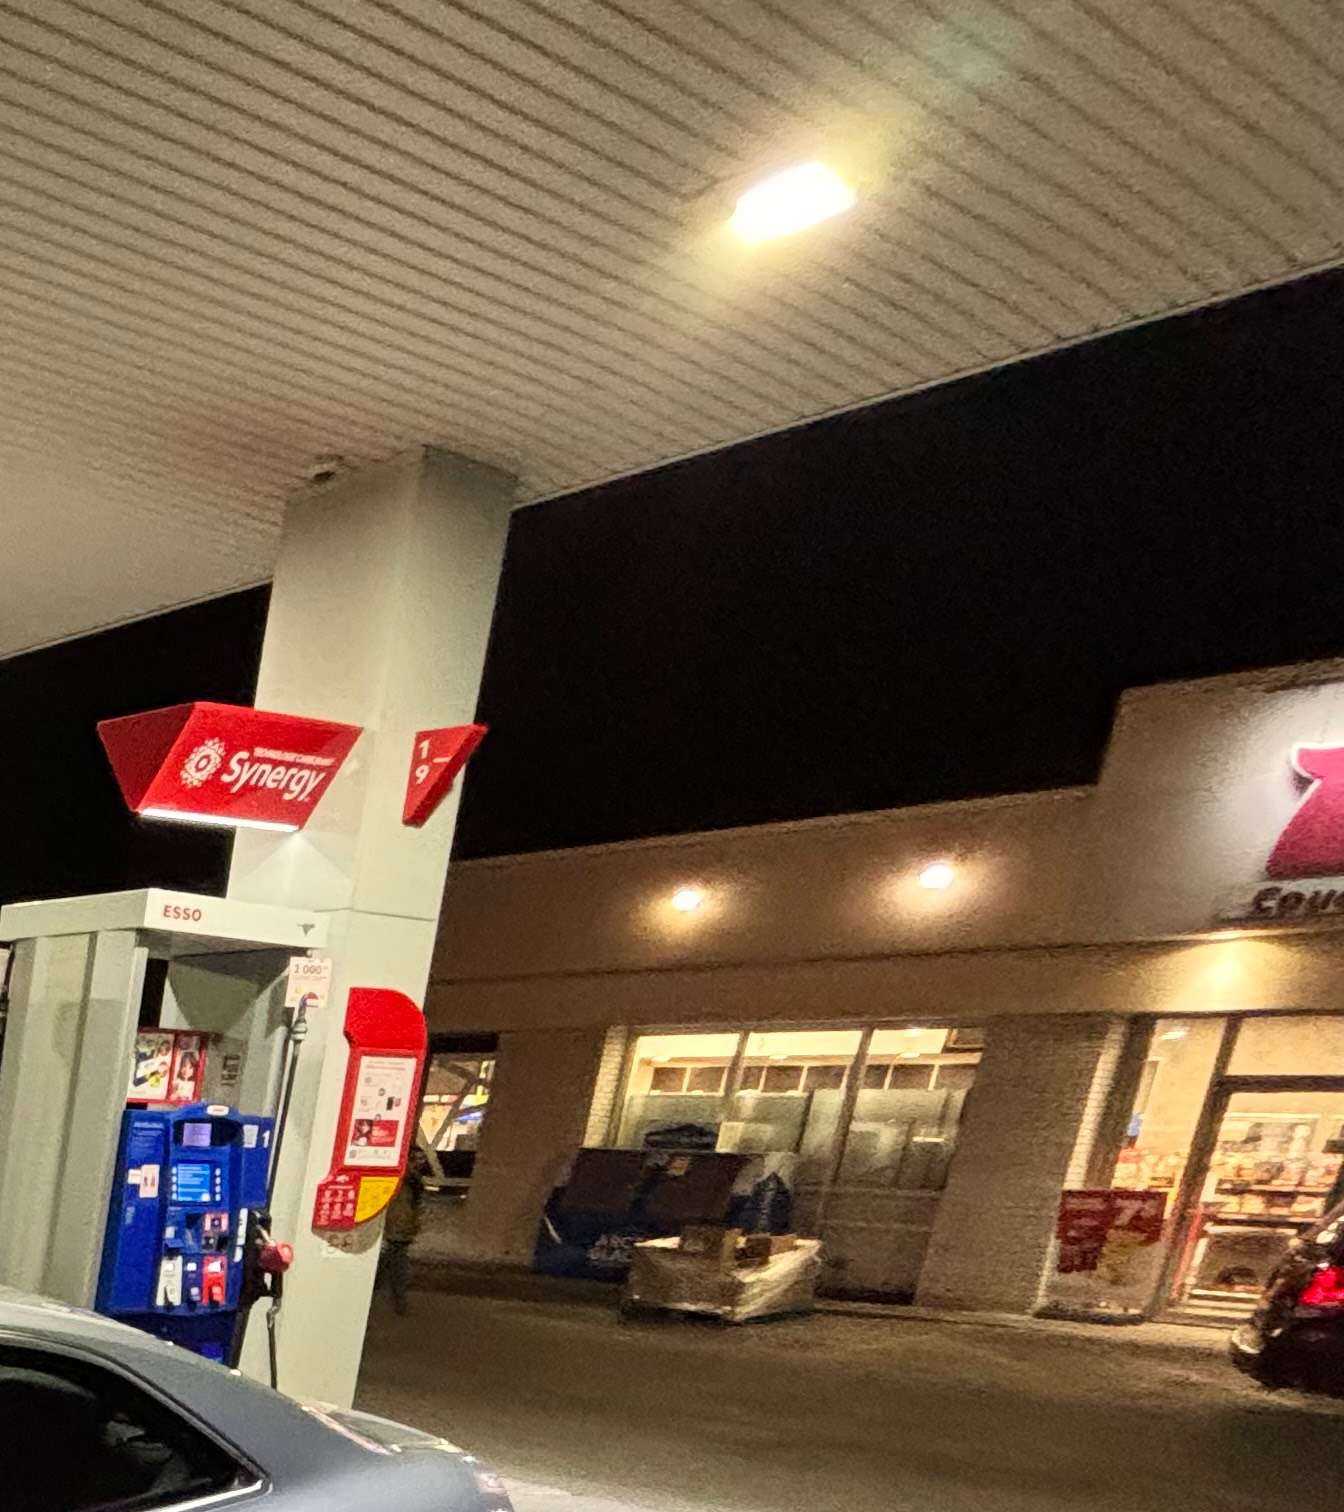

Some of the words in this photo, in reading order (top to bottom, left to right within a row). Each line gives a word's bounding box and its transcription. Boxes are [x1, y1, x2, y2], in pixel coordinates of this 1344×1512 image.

[419, 739, 431, 759] 1
[220, 751, 326, 801] Synergy
[415, 764, 430, 785] 9
[163, 904, 202, 923] ESSO
[262, 1130, 270, 1148] 1
